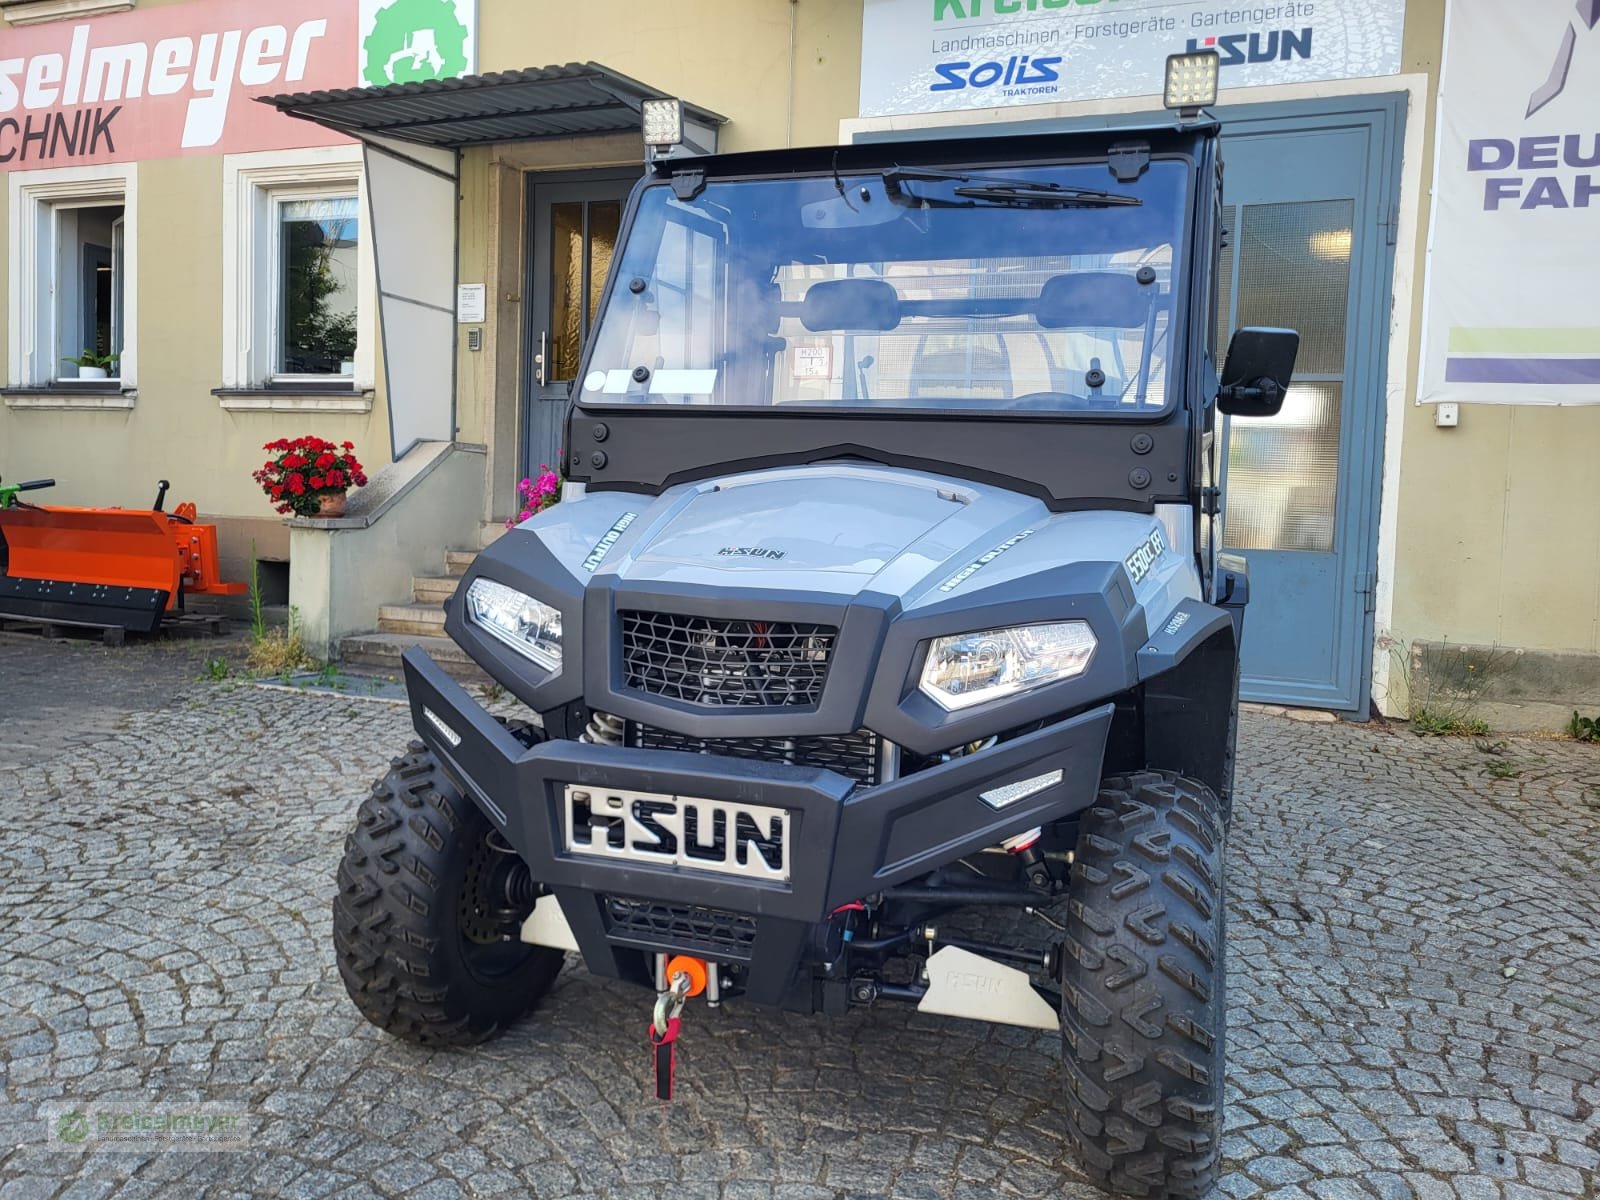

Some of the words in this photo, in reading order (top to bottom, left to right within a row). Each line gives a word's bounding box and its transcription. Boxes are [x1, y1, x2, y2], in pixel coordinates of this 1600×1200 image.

[932, 29, 1060, 53] Landmaschinen
[1074, 16, 1175, 39] Forstgeräte
[1191, 2, 1314, 28] Gartengeräte
[1003, 86, 1058, 97] TRAKTOREN
[612, 511, 638, 532] HIGH
[582, 529, 621, 572] OUTPUT
